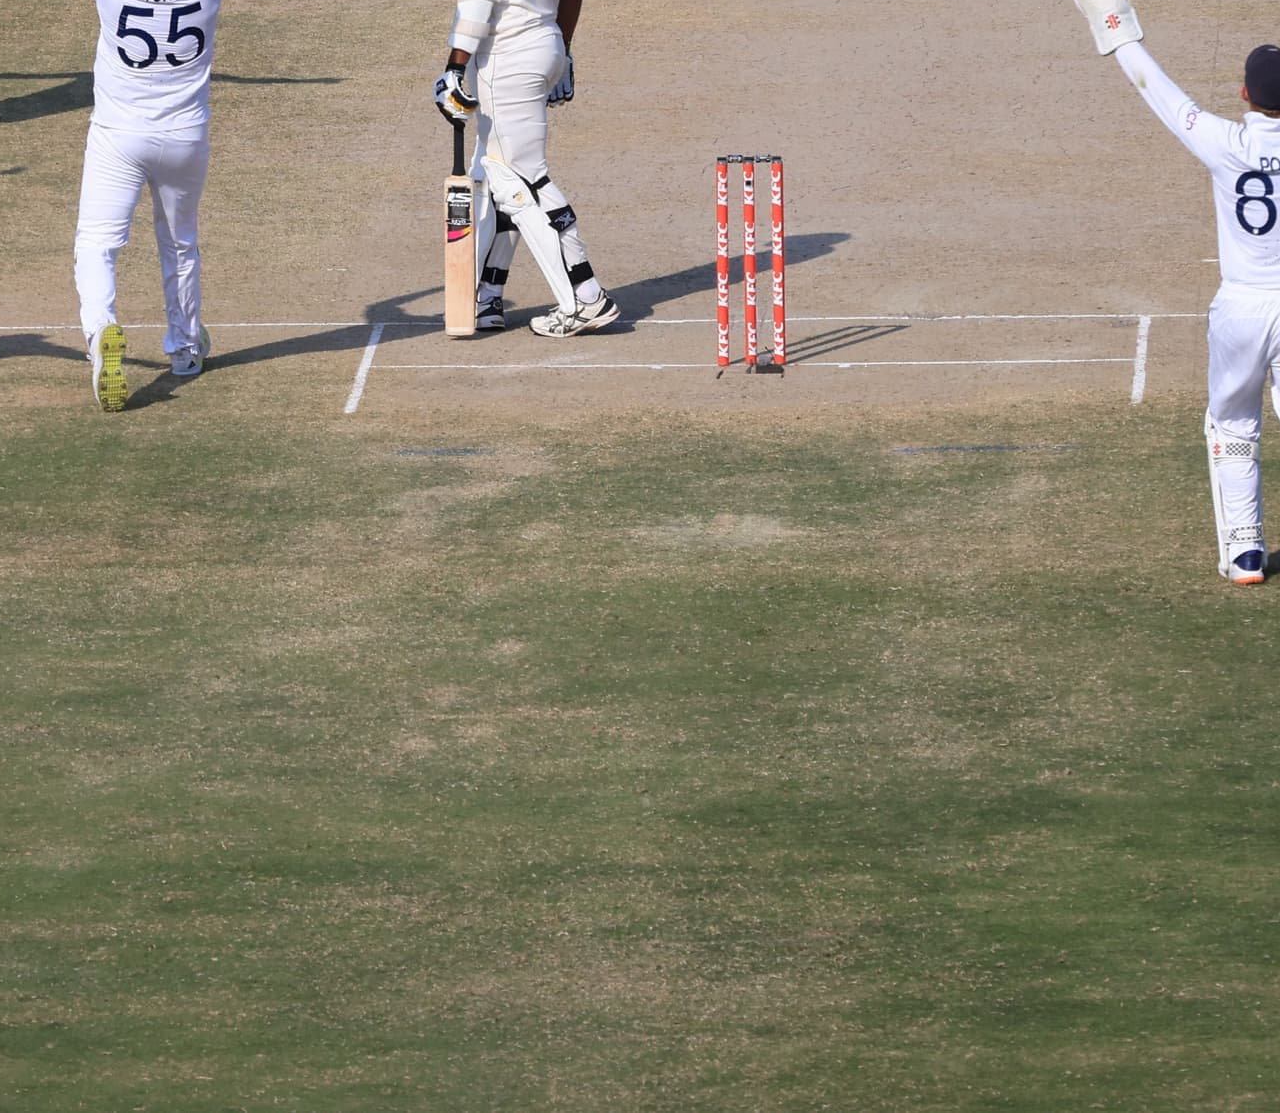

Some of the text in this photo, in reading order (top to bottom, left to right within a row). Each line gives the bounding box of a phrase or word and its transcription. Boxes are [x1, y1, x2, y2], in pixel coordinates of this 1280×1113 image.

[116, 1, 205, 69] 55
[717, 171, 728, 205] KFC
[771, 170, 781, 205] KFC
[717, 222, 728, 257] KFC
[744, 221, 755, 255] KFC
[772, 221, 783, 255] KFC
[717, 272, 729, 307] KFC
[745, 271, 756, 306] KFC
[773, 271, 784, 306] KFC
[718, 323, 729, 357] KFC
[747, 322, 757, 356] KFC
[774, 322, 784, 356] KFC
